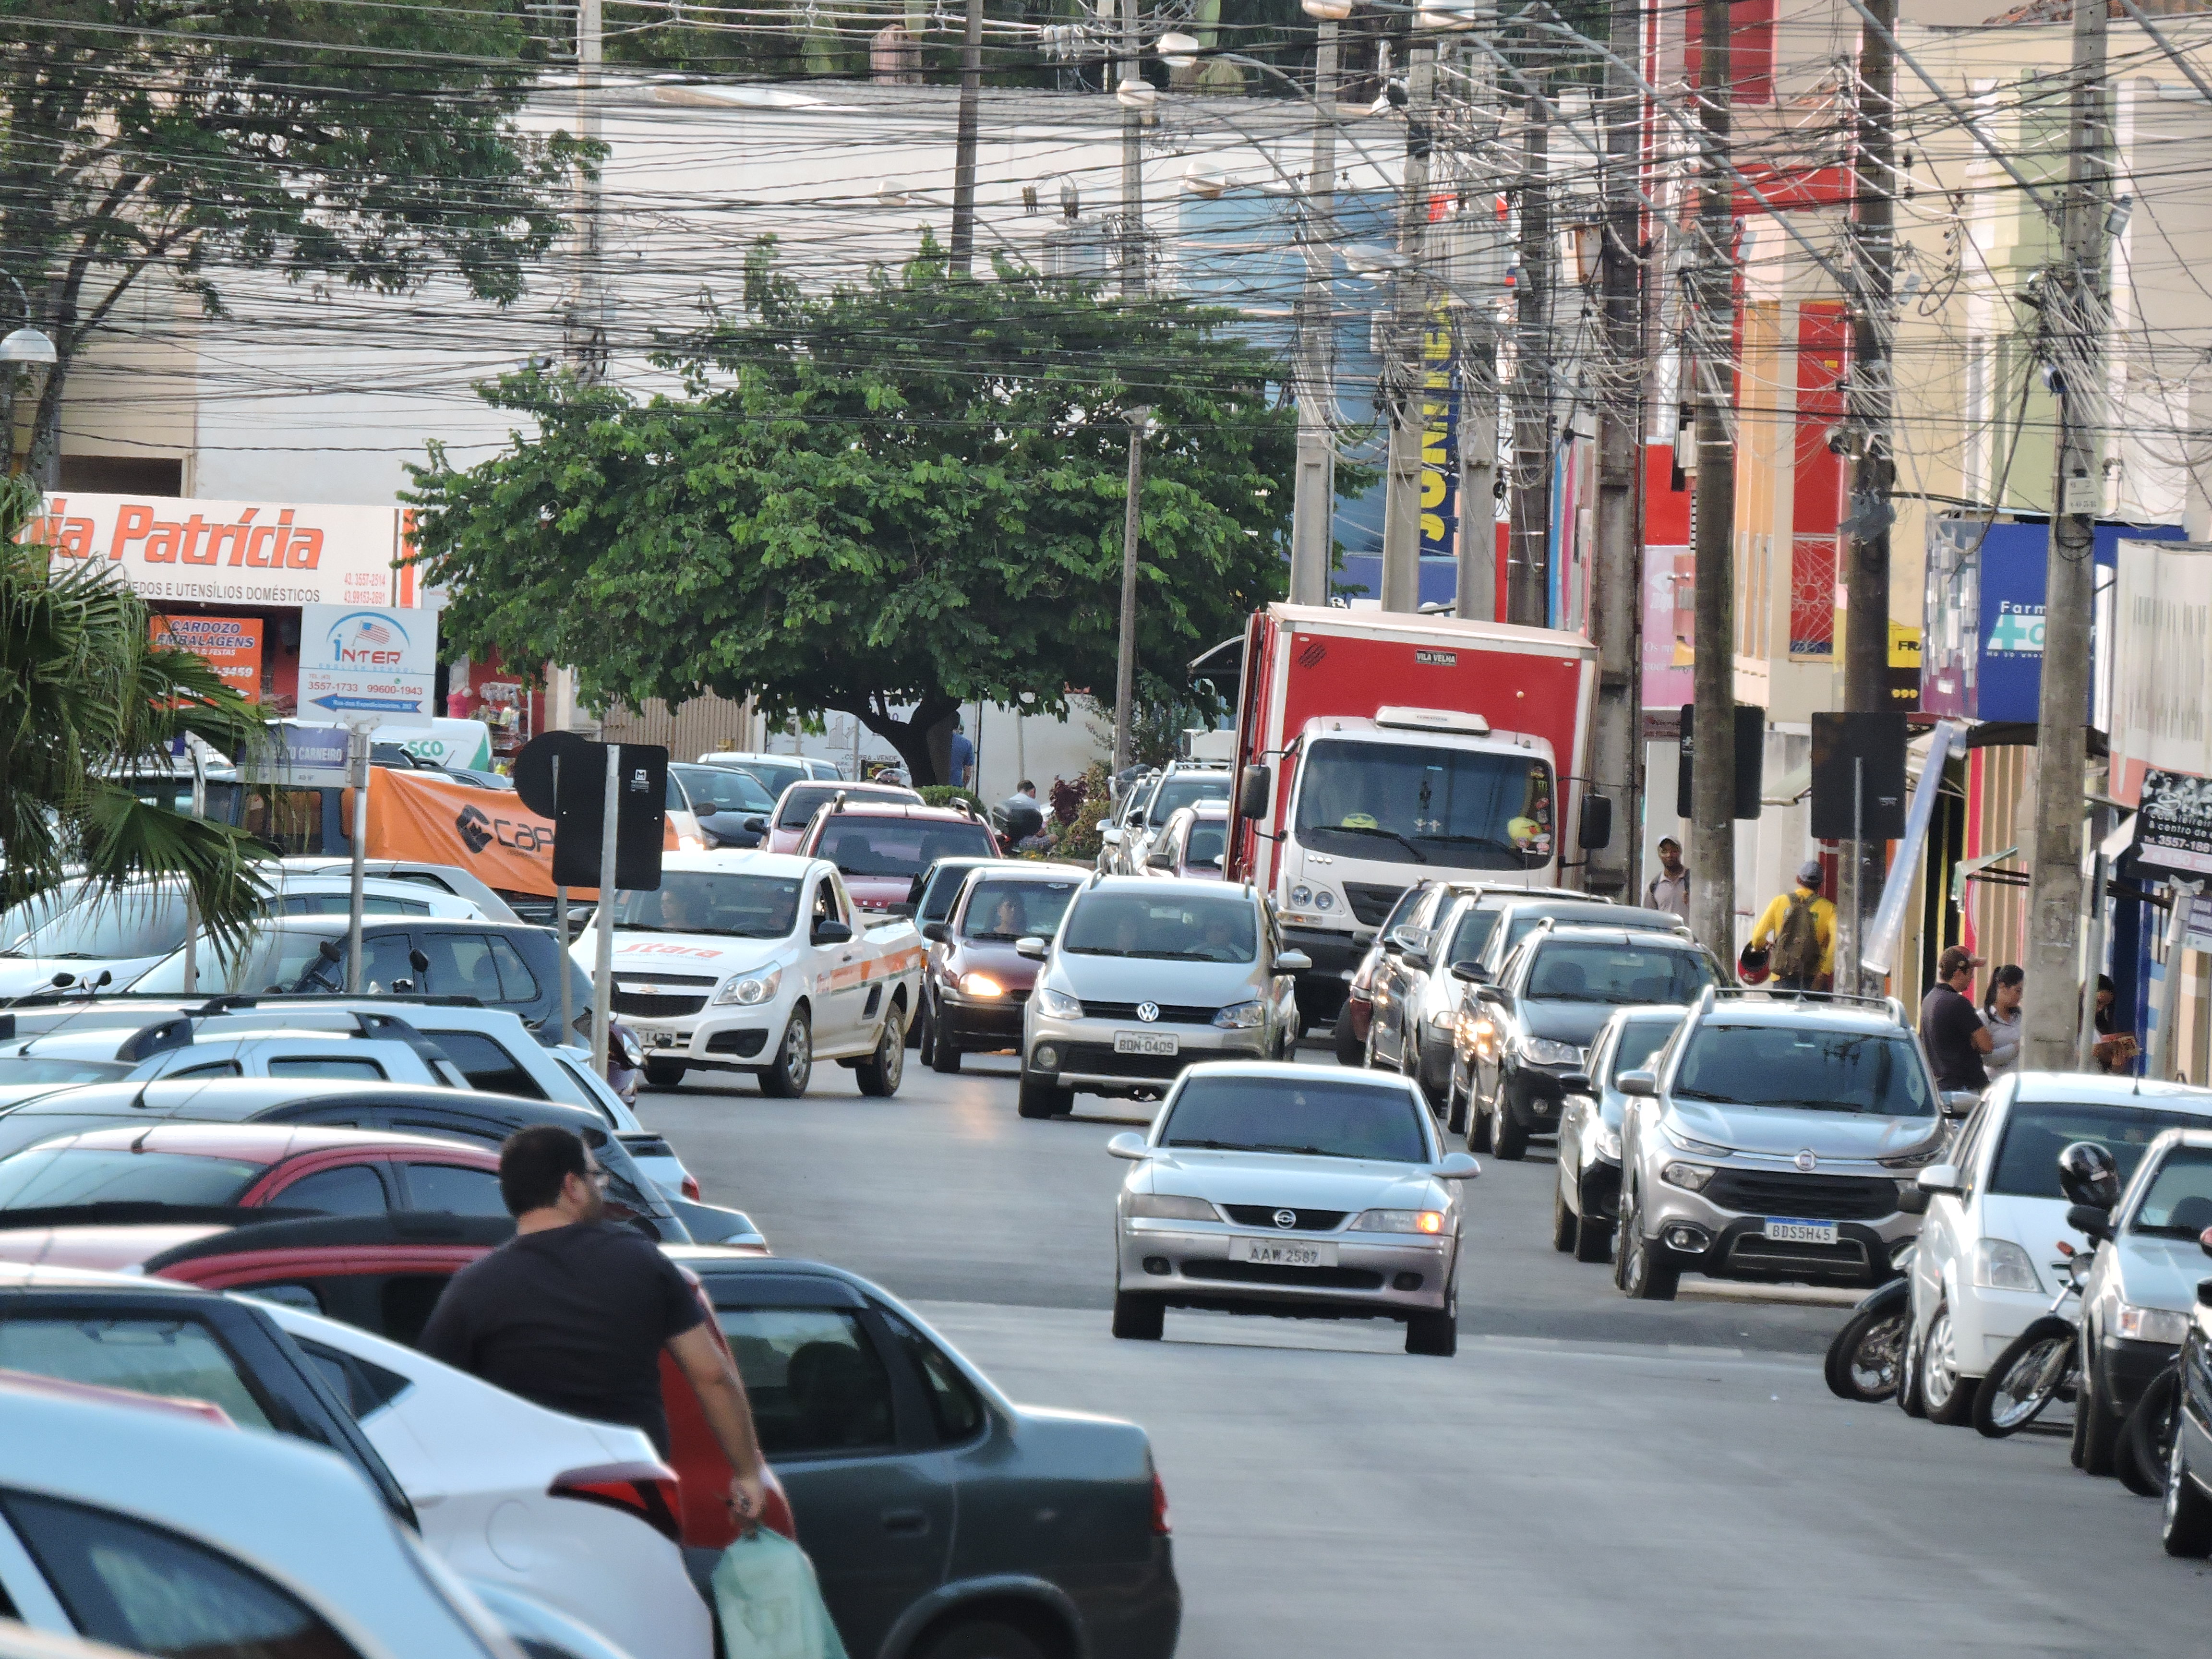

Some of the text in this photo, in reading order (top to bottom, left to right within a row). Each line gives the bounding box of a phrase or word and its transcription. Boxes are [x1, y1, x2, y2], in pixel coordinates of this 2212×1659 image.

[108, 504, 324, 570] Patrícia
[166, 582, 172, 595] E
[176, 581, 242, 600] UTENSÍLIOS
[246, 584, 320, 602] DOMÉSTICOS
[171, 620, 241, 634] CARDOZO
[156, 633, 255, 648] EMBALAGENS
[1433, 654, 1455, 663] VELHA
[308, 682, 422, 695] 3557-1733 99600-1943
[298, 746, 342, 762] CARNEIRO
[2158, 823, 2191, 835] centro
[615, 943, 723, 958] Stara
[1773, 1225, 1831, 1241] BDS5H45
